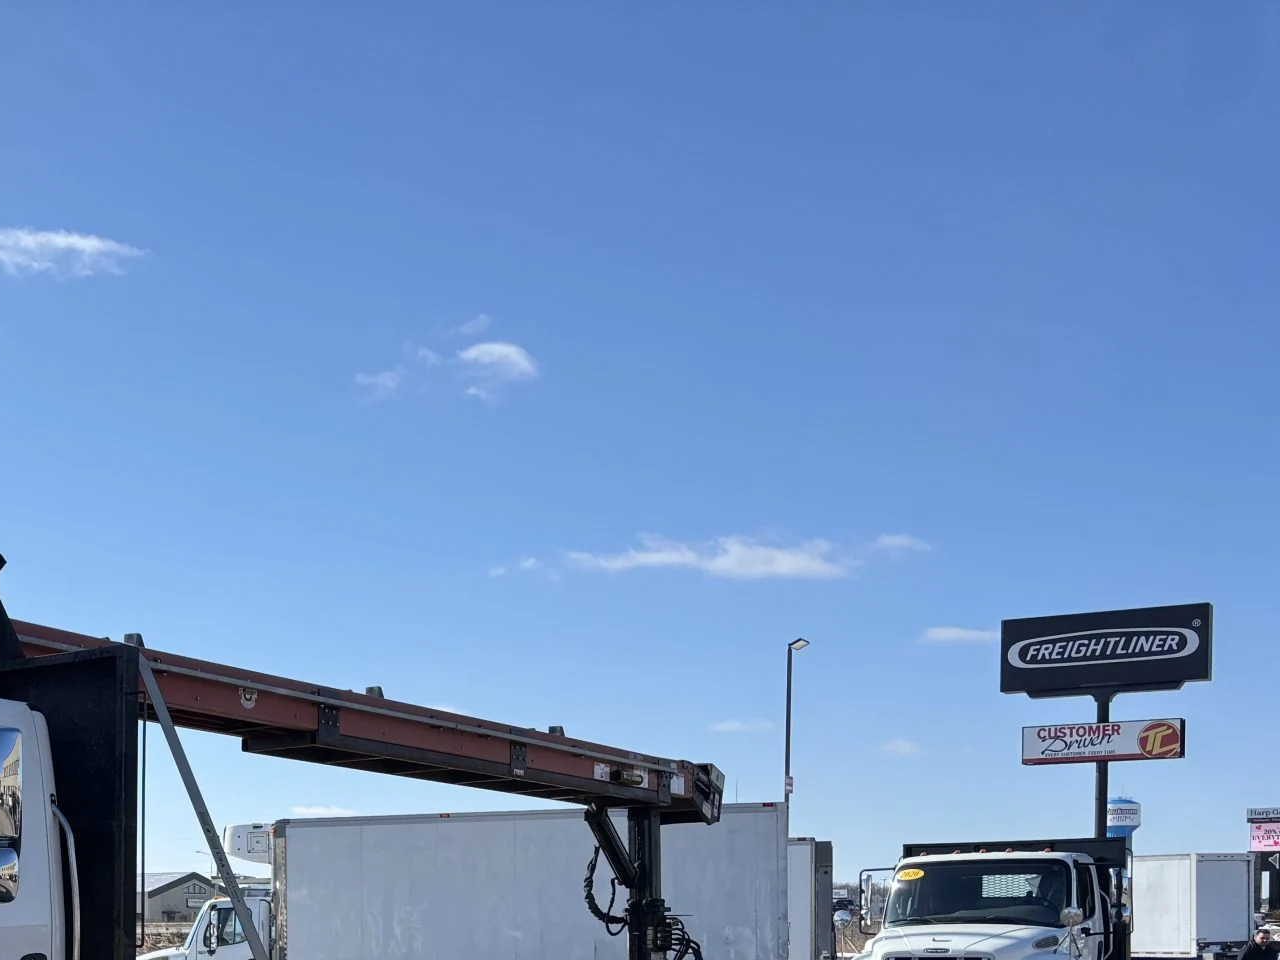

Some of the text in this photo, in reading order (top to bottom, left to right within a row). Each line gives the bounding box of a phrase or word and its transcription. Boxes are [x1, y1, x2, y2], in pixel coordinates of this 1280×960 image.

[1025, 635, 1180, 661] FREIGHTLINER
[1036, 723, 1121, 740] CUSTOMER
[1041, 733, 1113, 755] Driven
